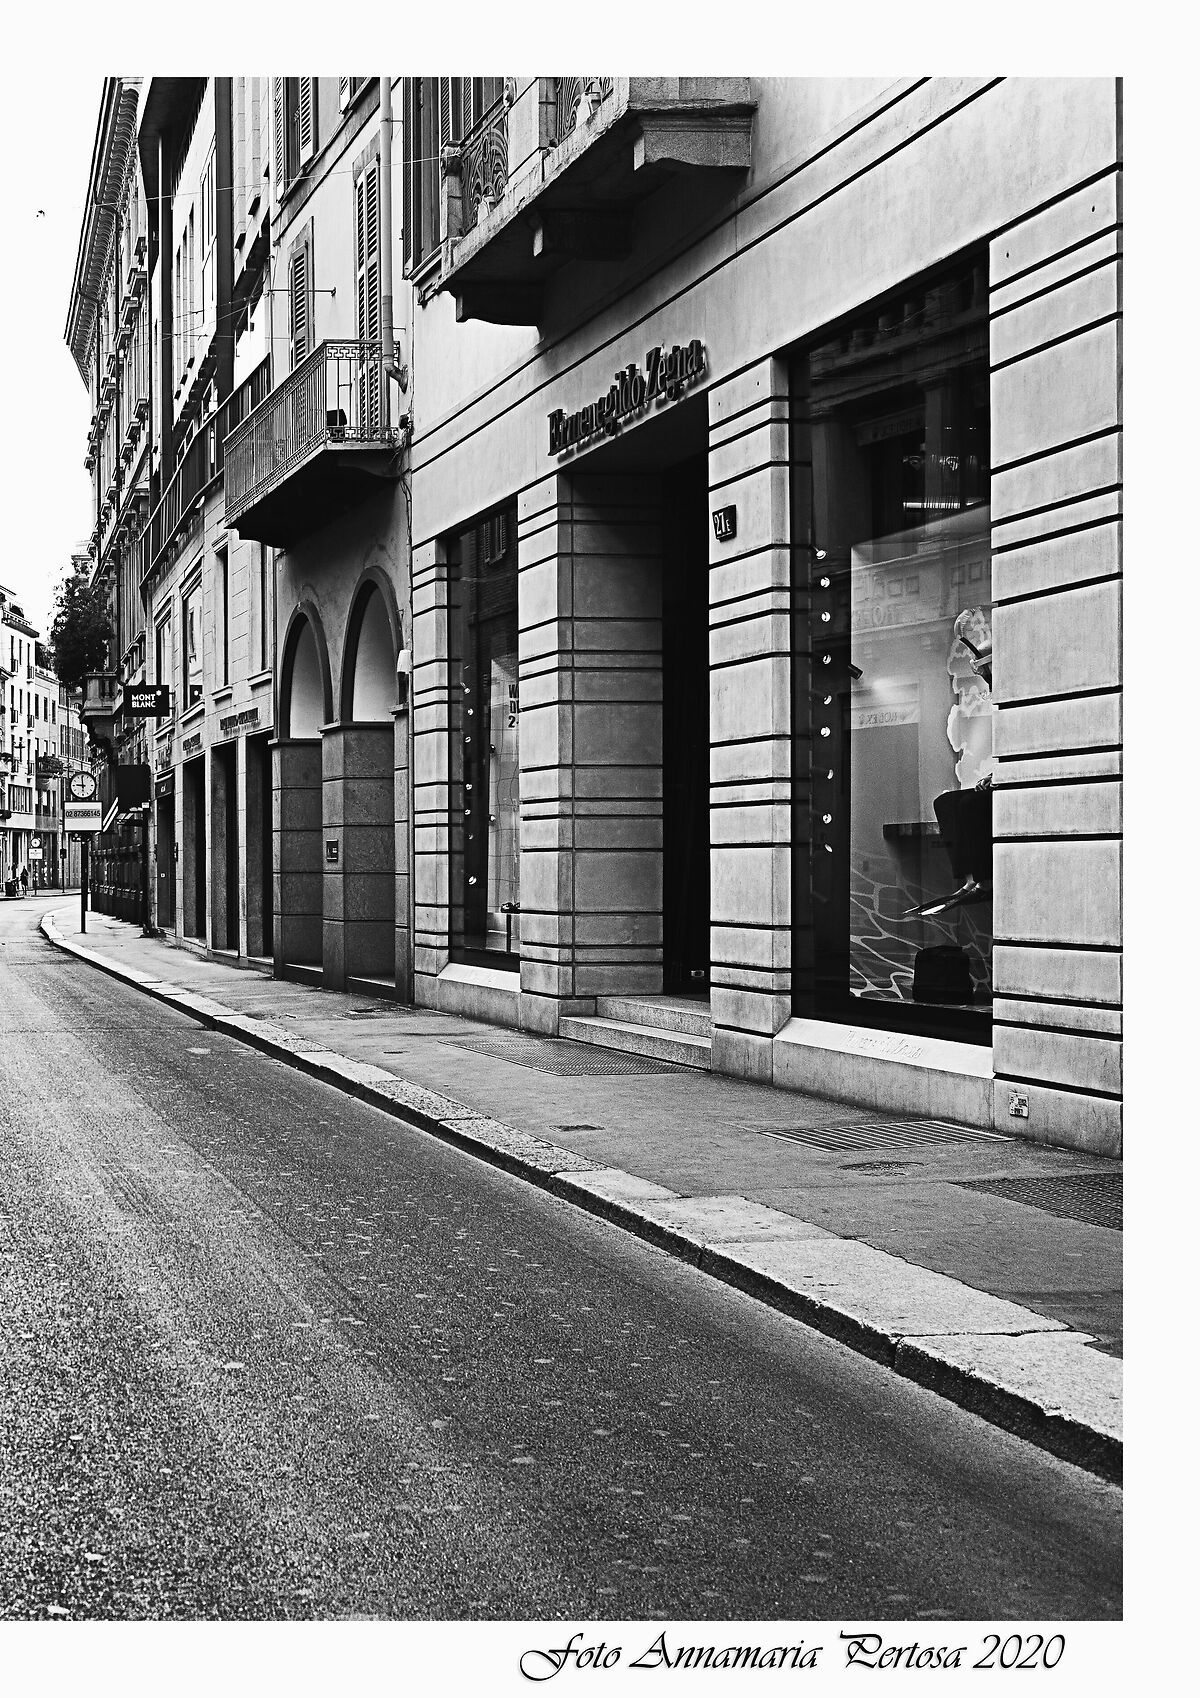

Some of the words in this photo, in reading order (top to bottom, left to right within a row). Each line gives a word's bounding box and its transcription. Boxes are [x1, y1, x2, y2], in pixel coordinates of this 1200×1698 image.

[548, 364, 644, 456] Ermenegildo
[644, 339, 706, 402] Zegna
[131, 693, 156, 701] MONT
[131, 700, 156, 708] BLANC
